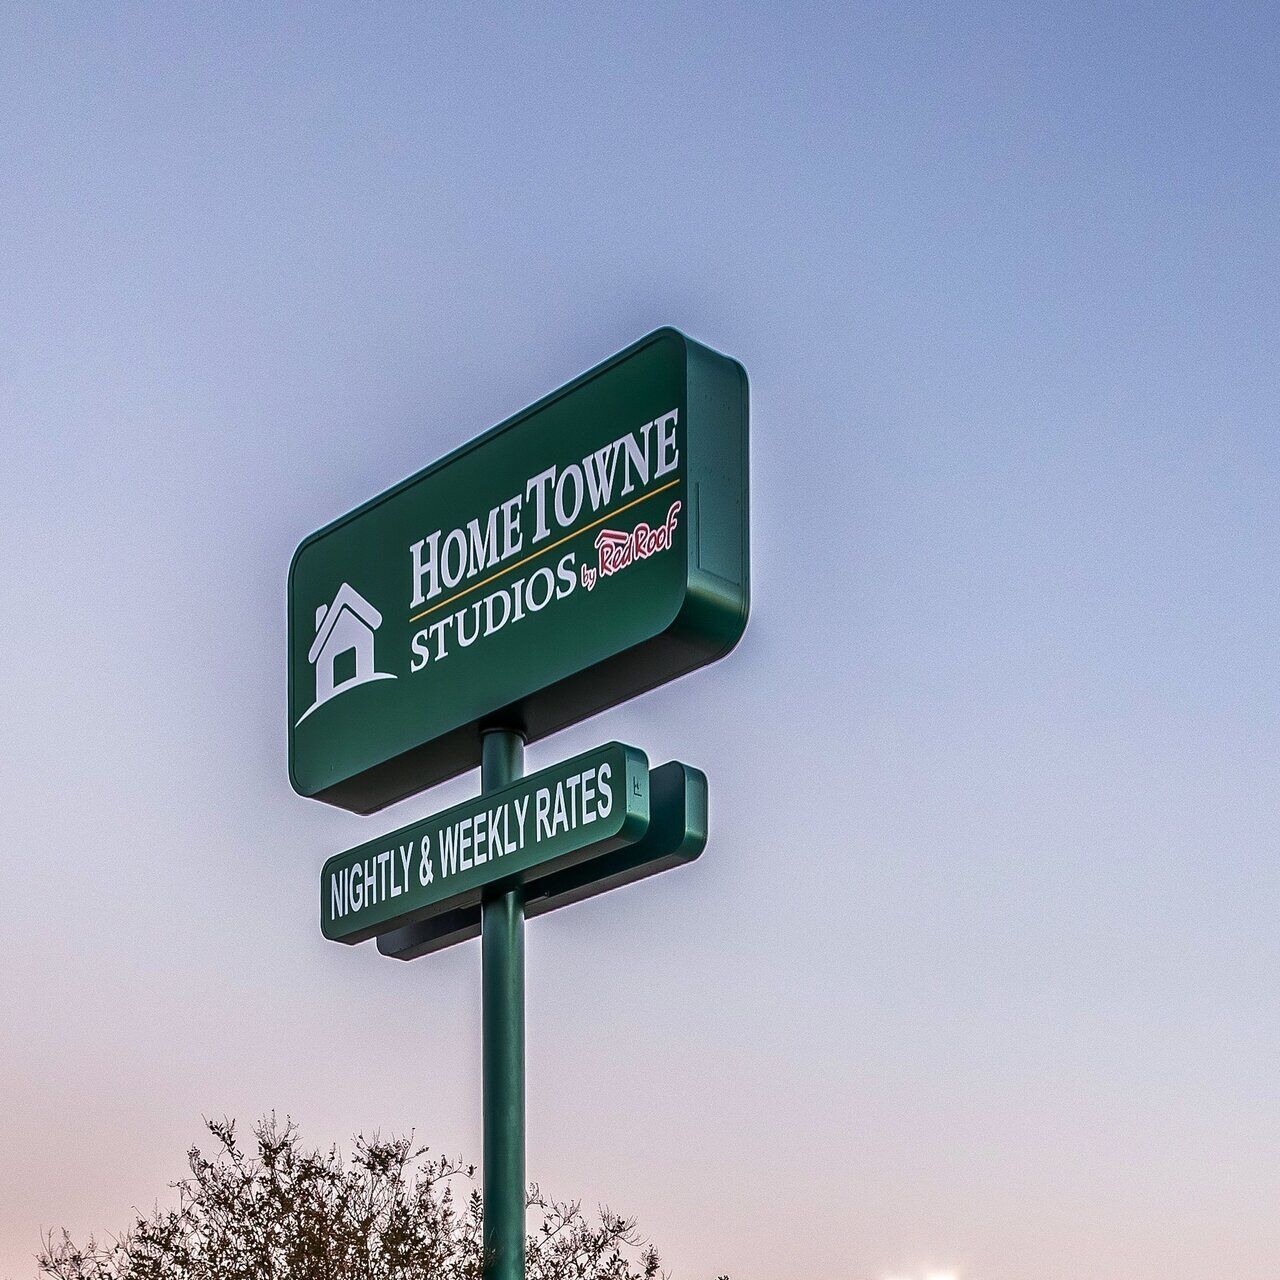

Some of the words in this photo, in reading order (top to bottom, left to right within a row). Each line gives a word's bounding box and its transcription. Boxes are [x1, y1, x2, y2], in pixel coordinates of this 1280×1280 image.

[410, 552, 577, 673] STUDIOS
[581, 563, 596, 591] by
[331, 842, 413, 920] NIGHTLY
[420, 835, 434, 887] &
[438, 795, 529, 878] WEEKLY
[536, 762, 613, 843] RATES
